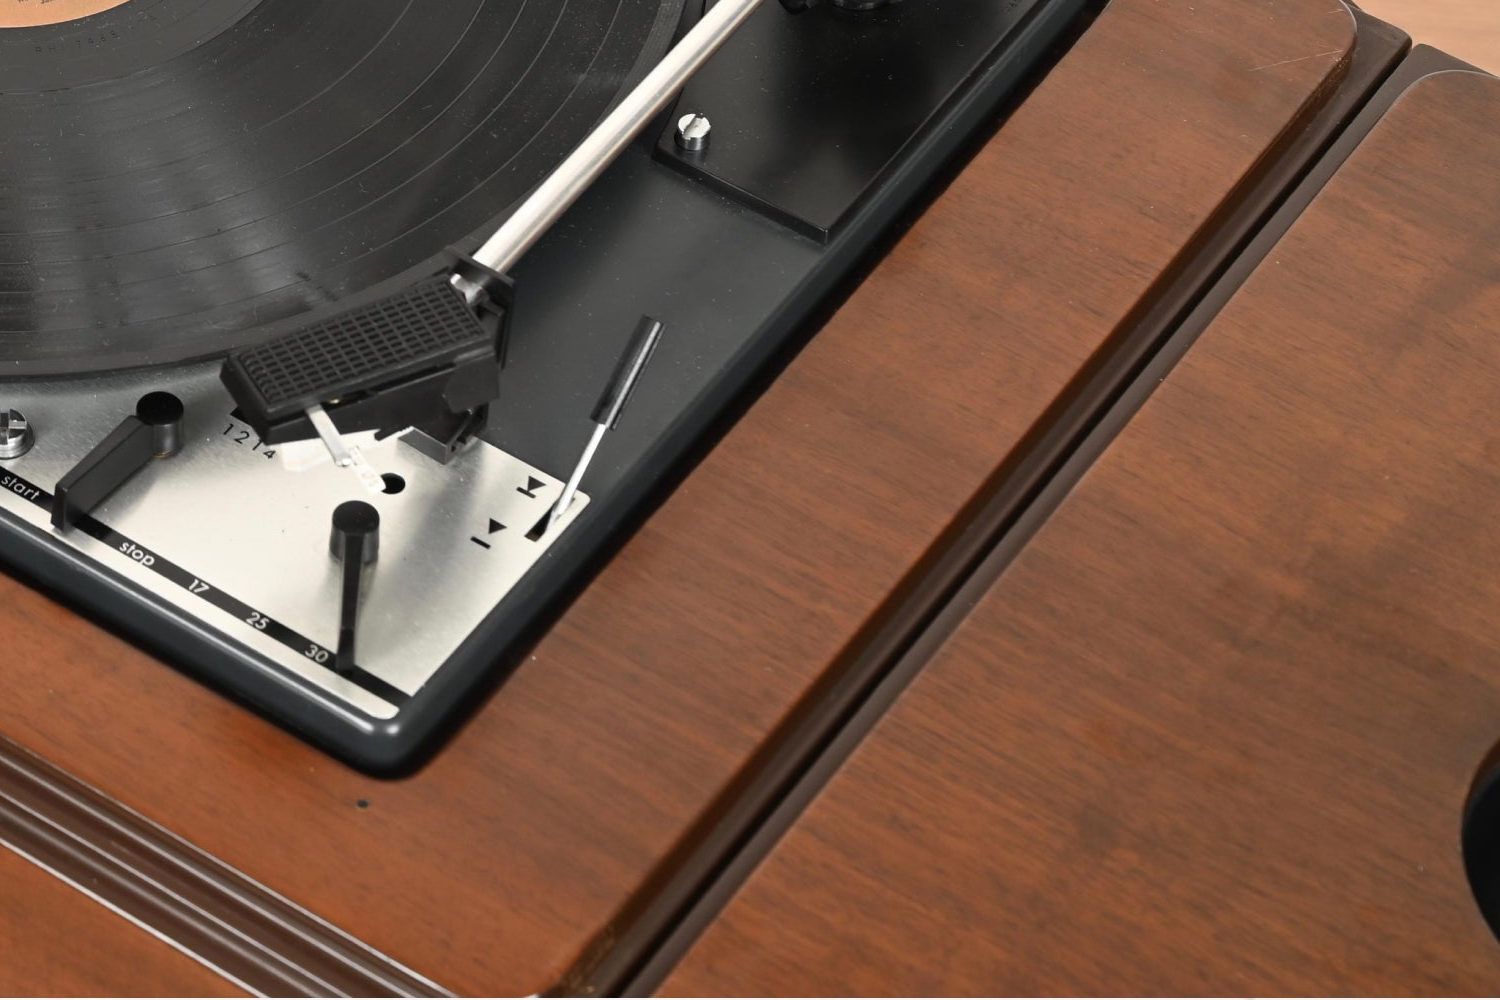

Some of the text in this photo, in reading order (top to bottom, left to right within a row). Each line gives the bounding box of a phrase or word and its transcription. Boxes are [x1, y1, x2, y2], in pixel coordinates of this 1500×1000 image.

[1, 472, 41, 501] start
[118, 539, 156, 568] stop
[188, 579, 210, 594] 17
[246, 611, 270, 631] 25
[304, 644, 329, 664] 30
